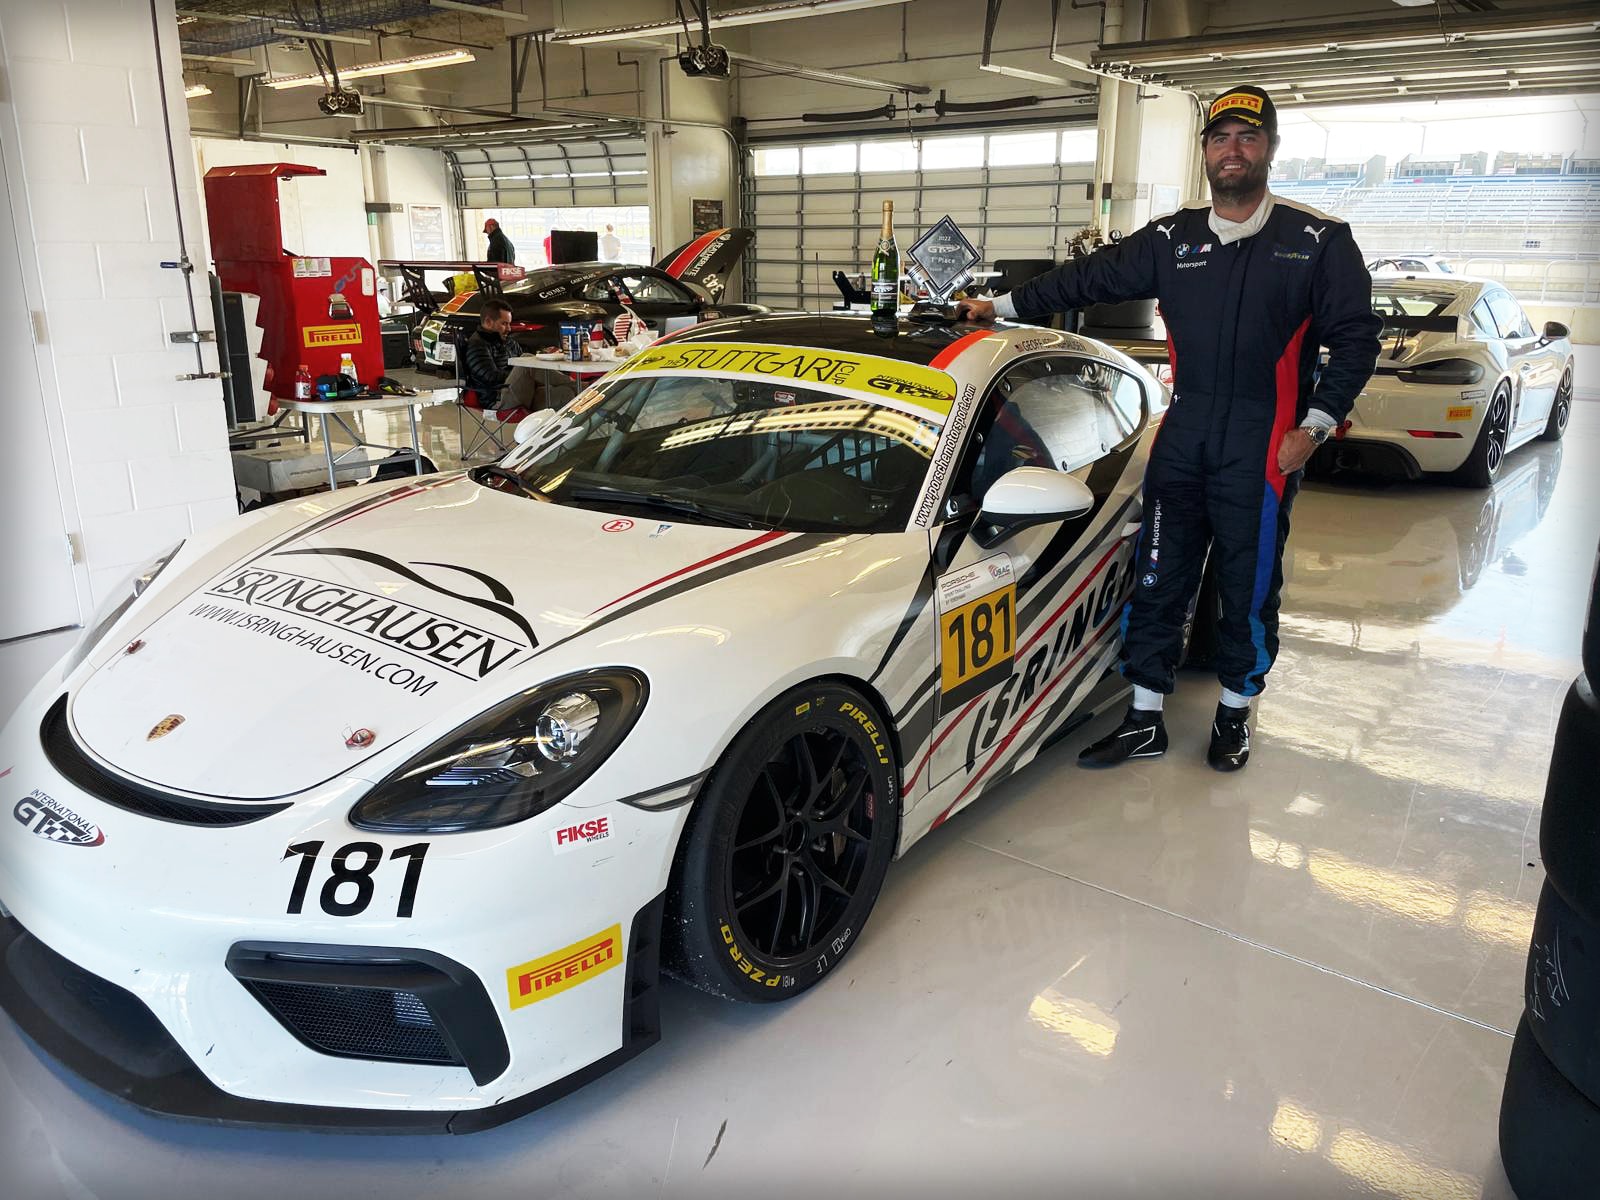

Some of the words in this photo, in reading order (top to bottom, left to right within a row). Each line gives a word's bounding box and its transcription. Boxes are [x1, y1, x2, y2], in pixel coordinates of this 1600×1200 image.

[1212, 95, 1259, 114] PIRELLI
[1176, 261, 1207, 270] Motorsport
[702, 273, 725, 295] 343
[307, 328, 357, 343] PIRELLI
[659, 349, 860, 382] STUTTGART
[664, 359, 681, 367] THE
[876, 374, 945, 398] INTERNATIONAL
[915, 383, 977, 528] www.porschemotorsport.com
[941, 571, 976, 590] PORSCHE
[210, 569, 522, 679] ISRINGHAUSEN
[949, 592, 1011, 679] 181
[189, 603, 439, 697] WWW.ISRINGHAUSEN.COM
[839, 702, 889, 764] PIRELLI
[30, 788, 96, 834] INTERNATIONAL
[556, 817, 609, 845] FIKSE
[586, 831, 609, 843] WHEELS
[282, 840, 430, 918] 181
[518, 938, 614, 997] PIRELLI
